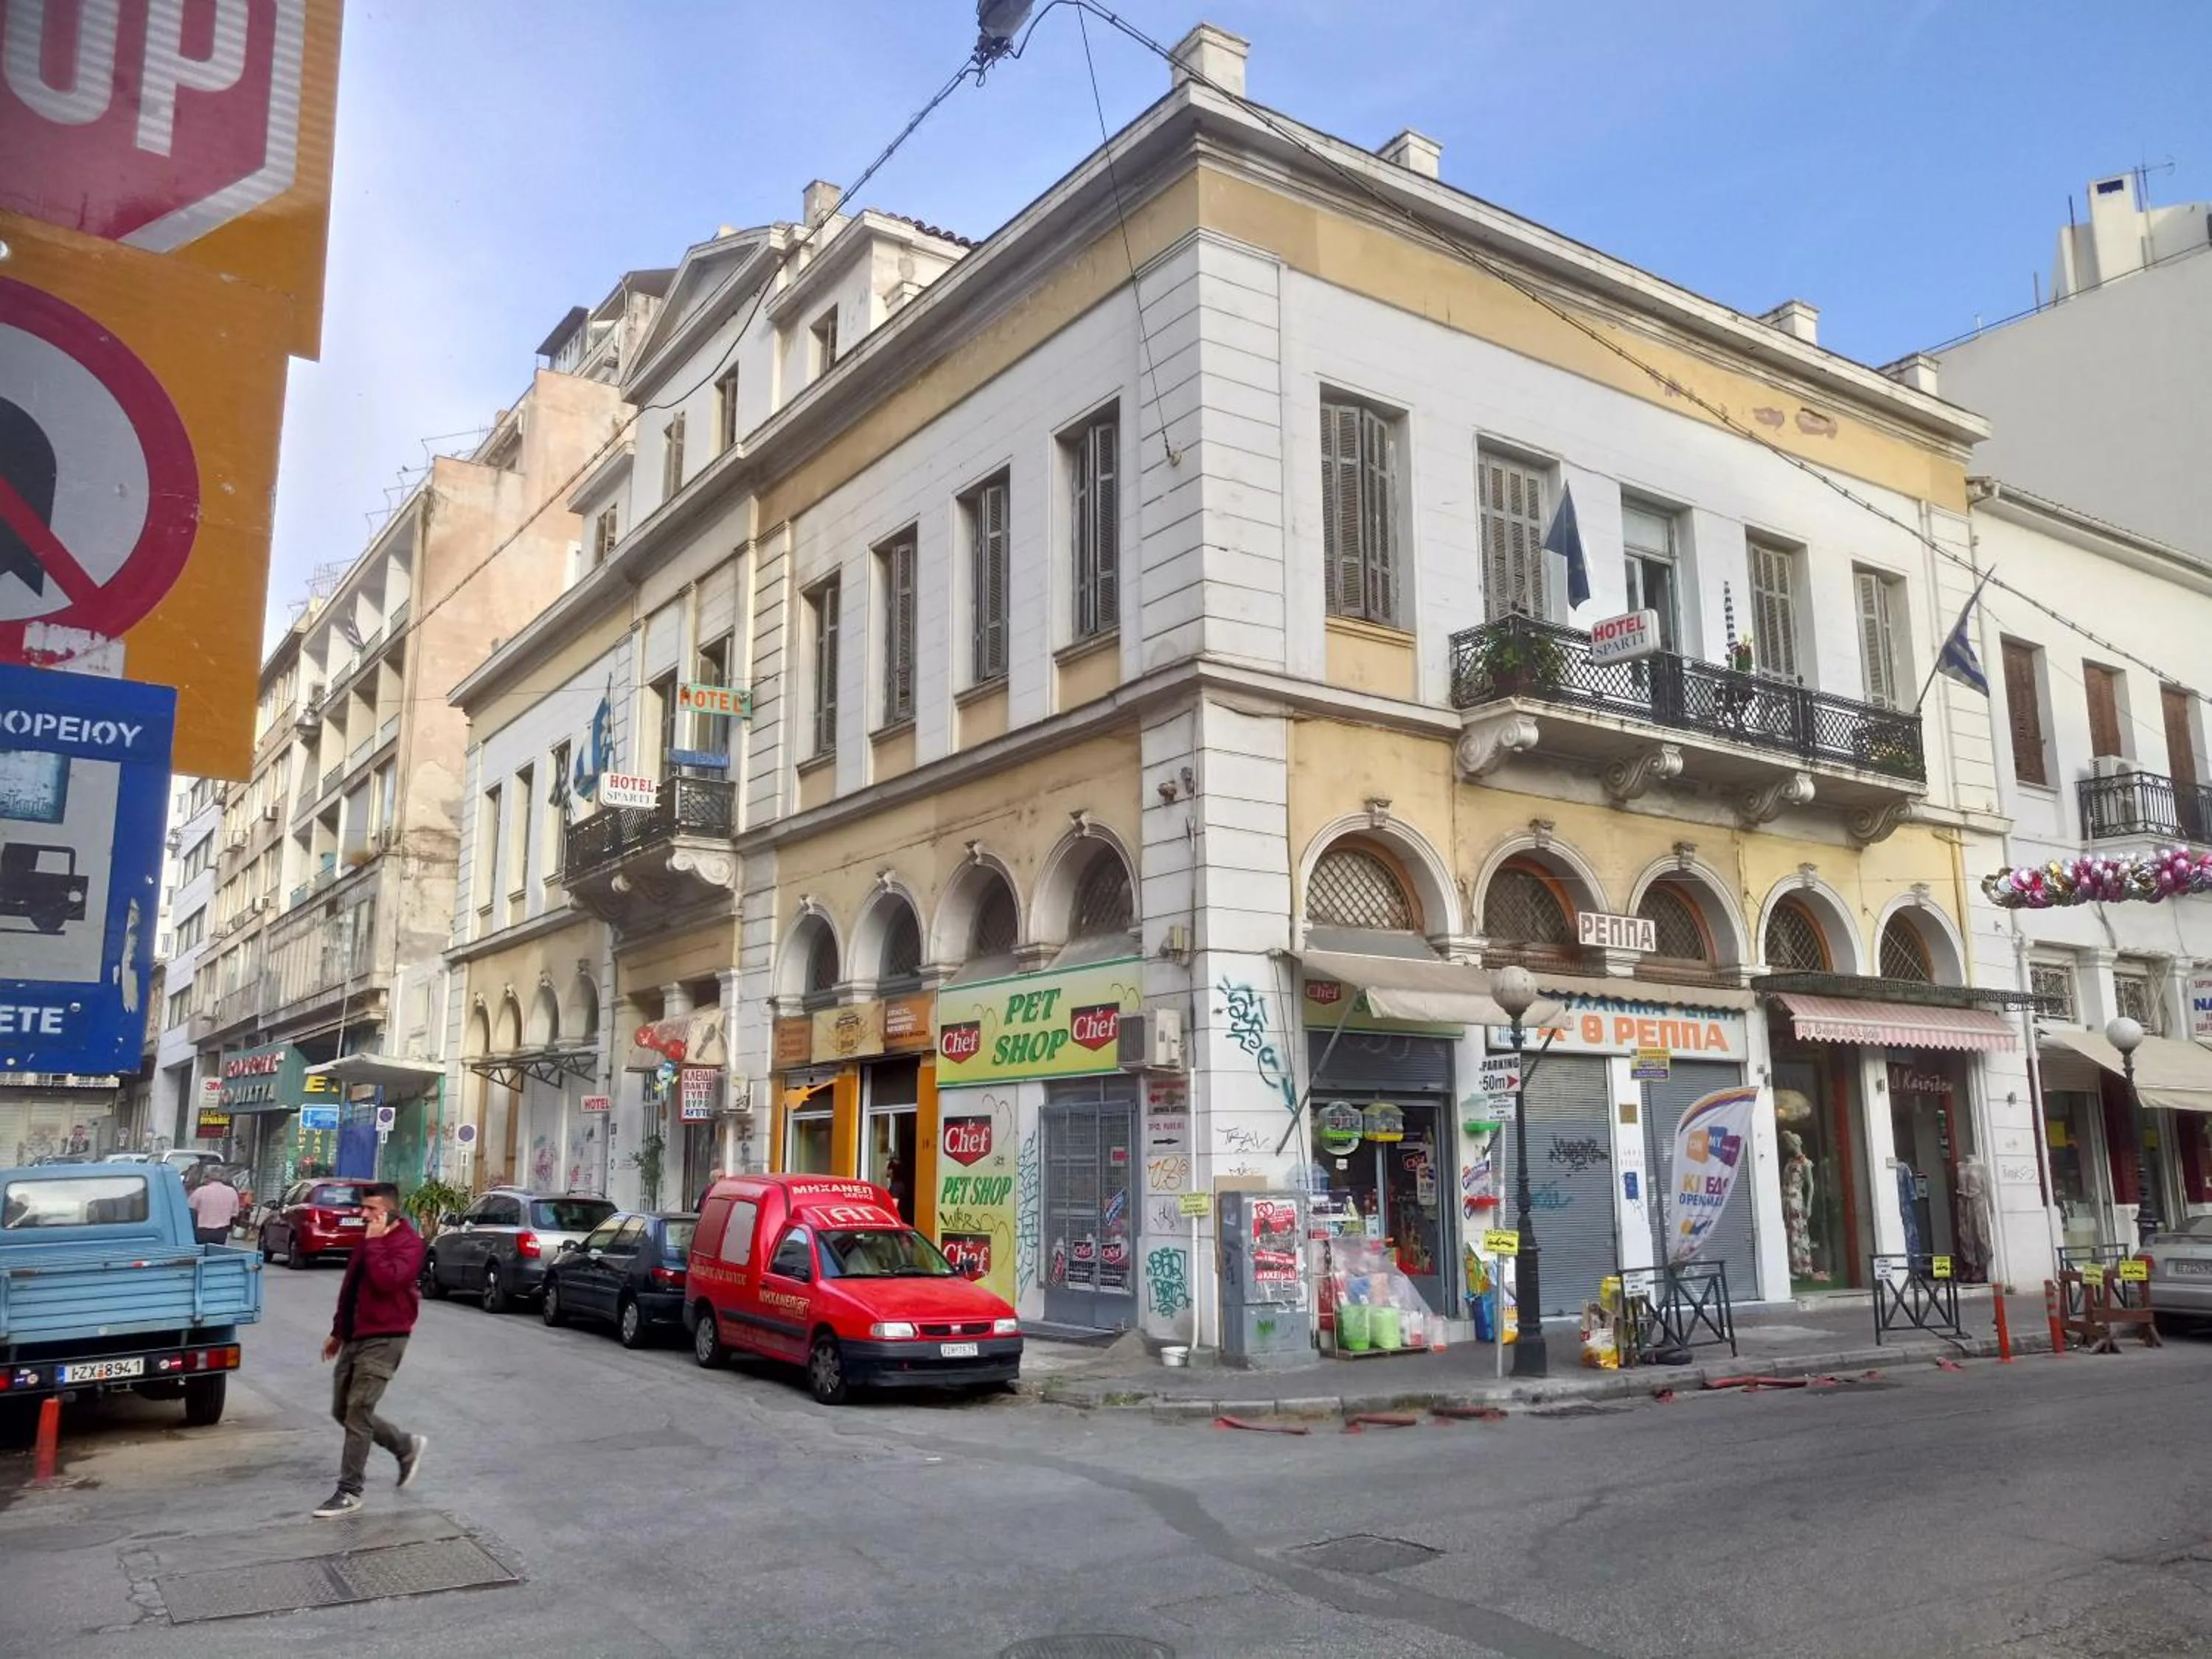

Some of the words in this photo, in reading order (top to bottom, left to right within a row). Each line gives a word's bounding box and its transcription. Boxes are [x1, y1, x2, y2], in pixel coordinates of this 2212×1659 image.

[1594, 616, 1645, 642] HOTEL
[1596, 632, 1644, 656] SPARTI
[679, 687, 743, 713] HOTEL
[0, 710, 142, 748] ΟΡΕΙΟΥ
[607, 790, 650, 802] SPARTI
[610, 775, 654, 793] HOTEL
[1580, 914, 1654, 948] ΡΕΠΠΑ
[1004, 988, 1062, 1026] PET
[1073, 1012, 1119, 1041] Chef
[1615, 1017, 1730, 1052] ΡΕΠΠΑ
[942, 1029, 978, 1054] Chef
[991, 1029, 1068, 1065] SHOP
[1482, 1057, 1520, 1071] PARKING
[684, 1082, 712, 1091] ΠΑΝΤΟ
[1483, 1075, 1505, 1091] 50m
[585, 1097, 610, 1110] HOTEL
[945, 1127, 990, 1152] Chef
[792, 1184, 873, 1194] ΜΗΧΑΝΕΠ
[941, 1176, 972, 1204] PET
[970, 1176, 1012, 1205] SHOP
[105, 1360, 141, 1375] 8941
